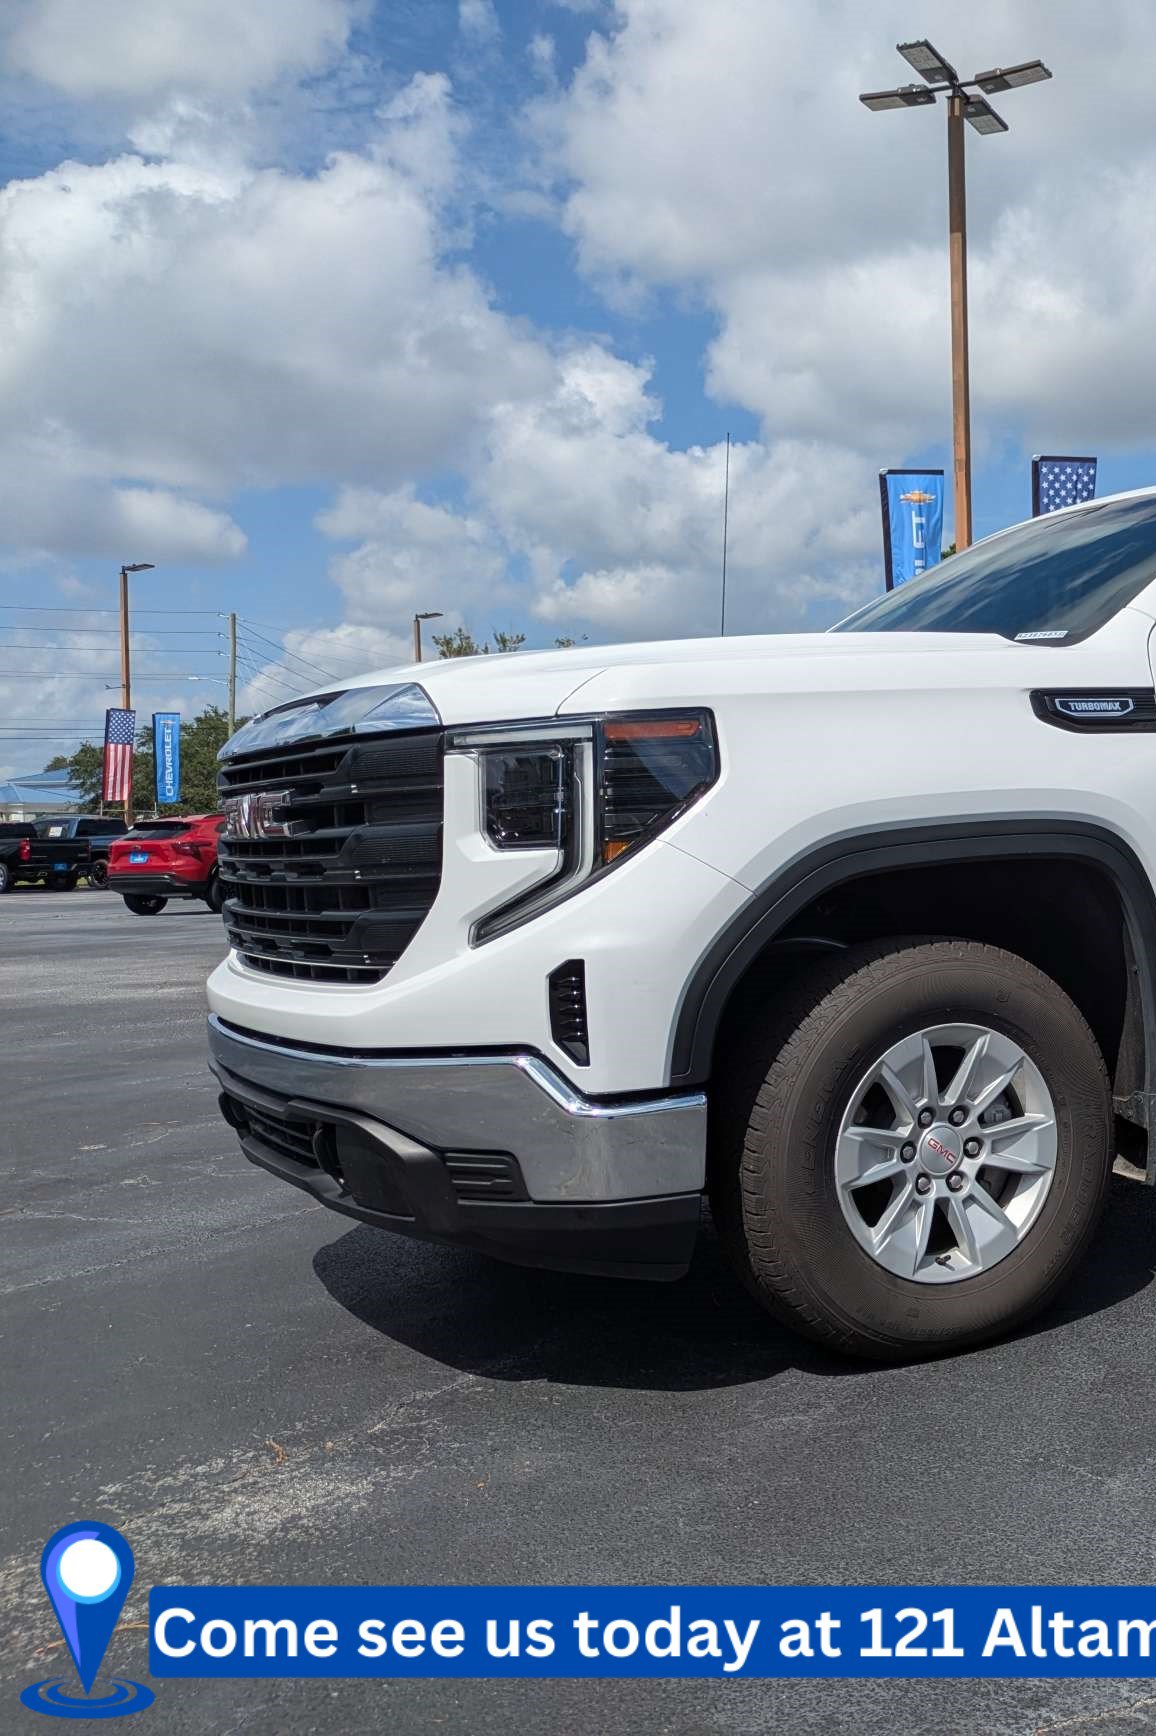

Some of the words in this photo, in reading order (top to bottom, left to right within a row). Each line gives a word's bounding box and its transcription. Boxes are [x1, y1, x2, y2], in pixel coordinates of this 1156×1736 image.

[1068, 701, 1122, 712] TURBOMAX
[164, 727, 174, 797] CHEVROLET
[926, 1136, 957, 1165] GMC
